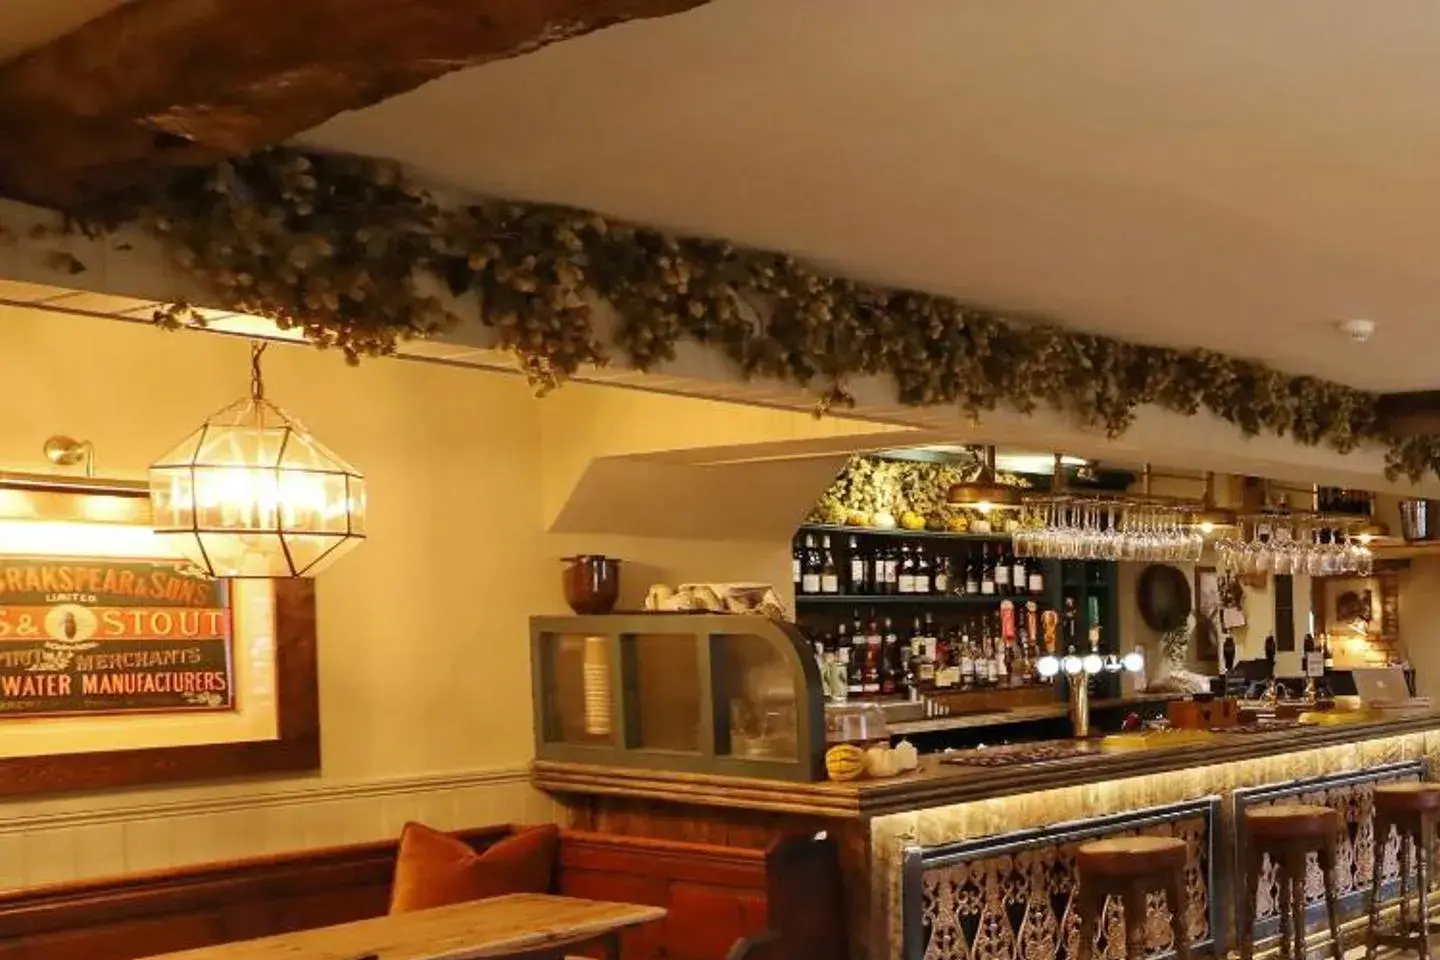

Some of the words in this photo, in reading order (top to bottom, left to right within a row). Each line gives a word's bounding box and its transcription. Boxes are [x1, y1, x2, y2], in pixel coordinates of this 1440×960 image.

[16, 614, 41, 636] &
[101, 611, 224, 636] STOUT
[76, 648, 201, 671] MERCHANTS
[1, 674, 71, 697] WATER
[82, 671, 225, 695] MANUFACTURERS
